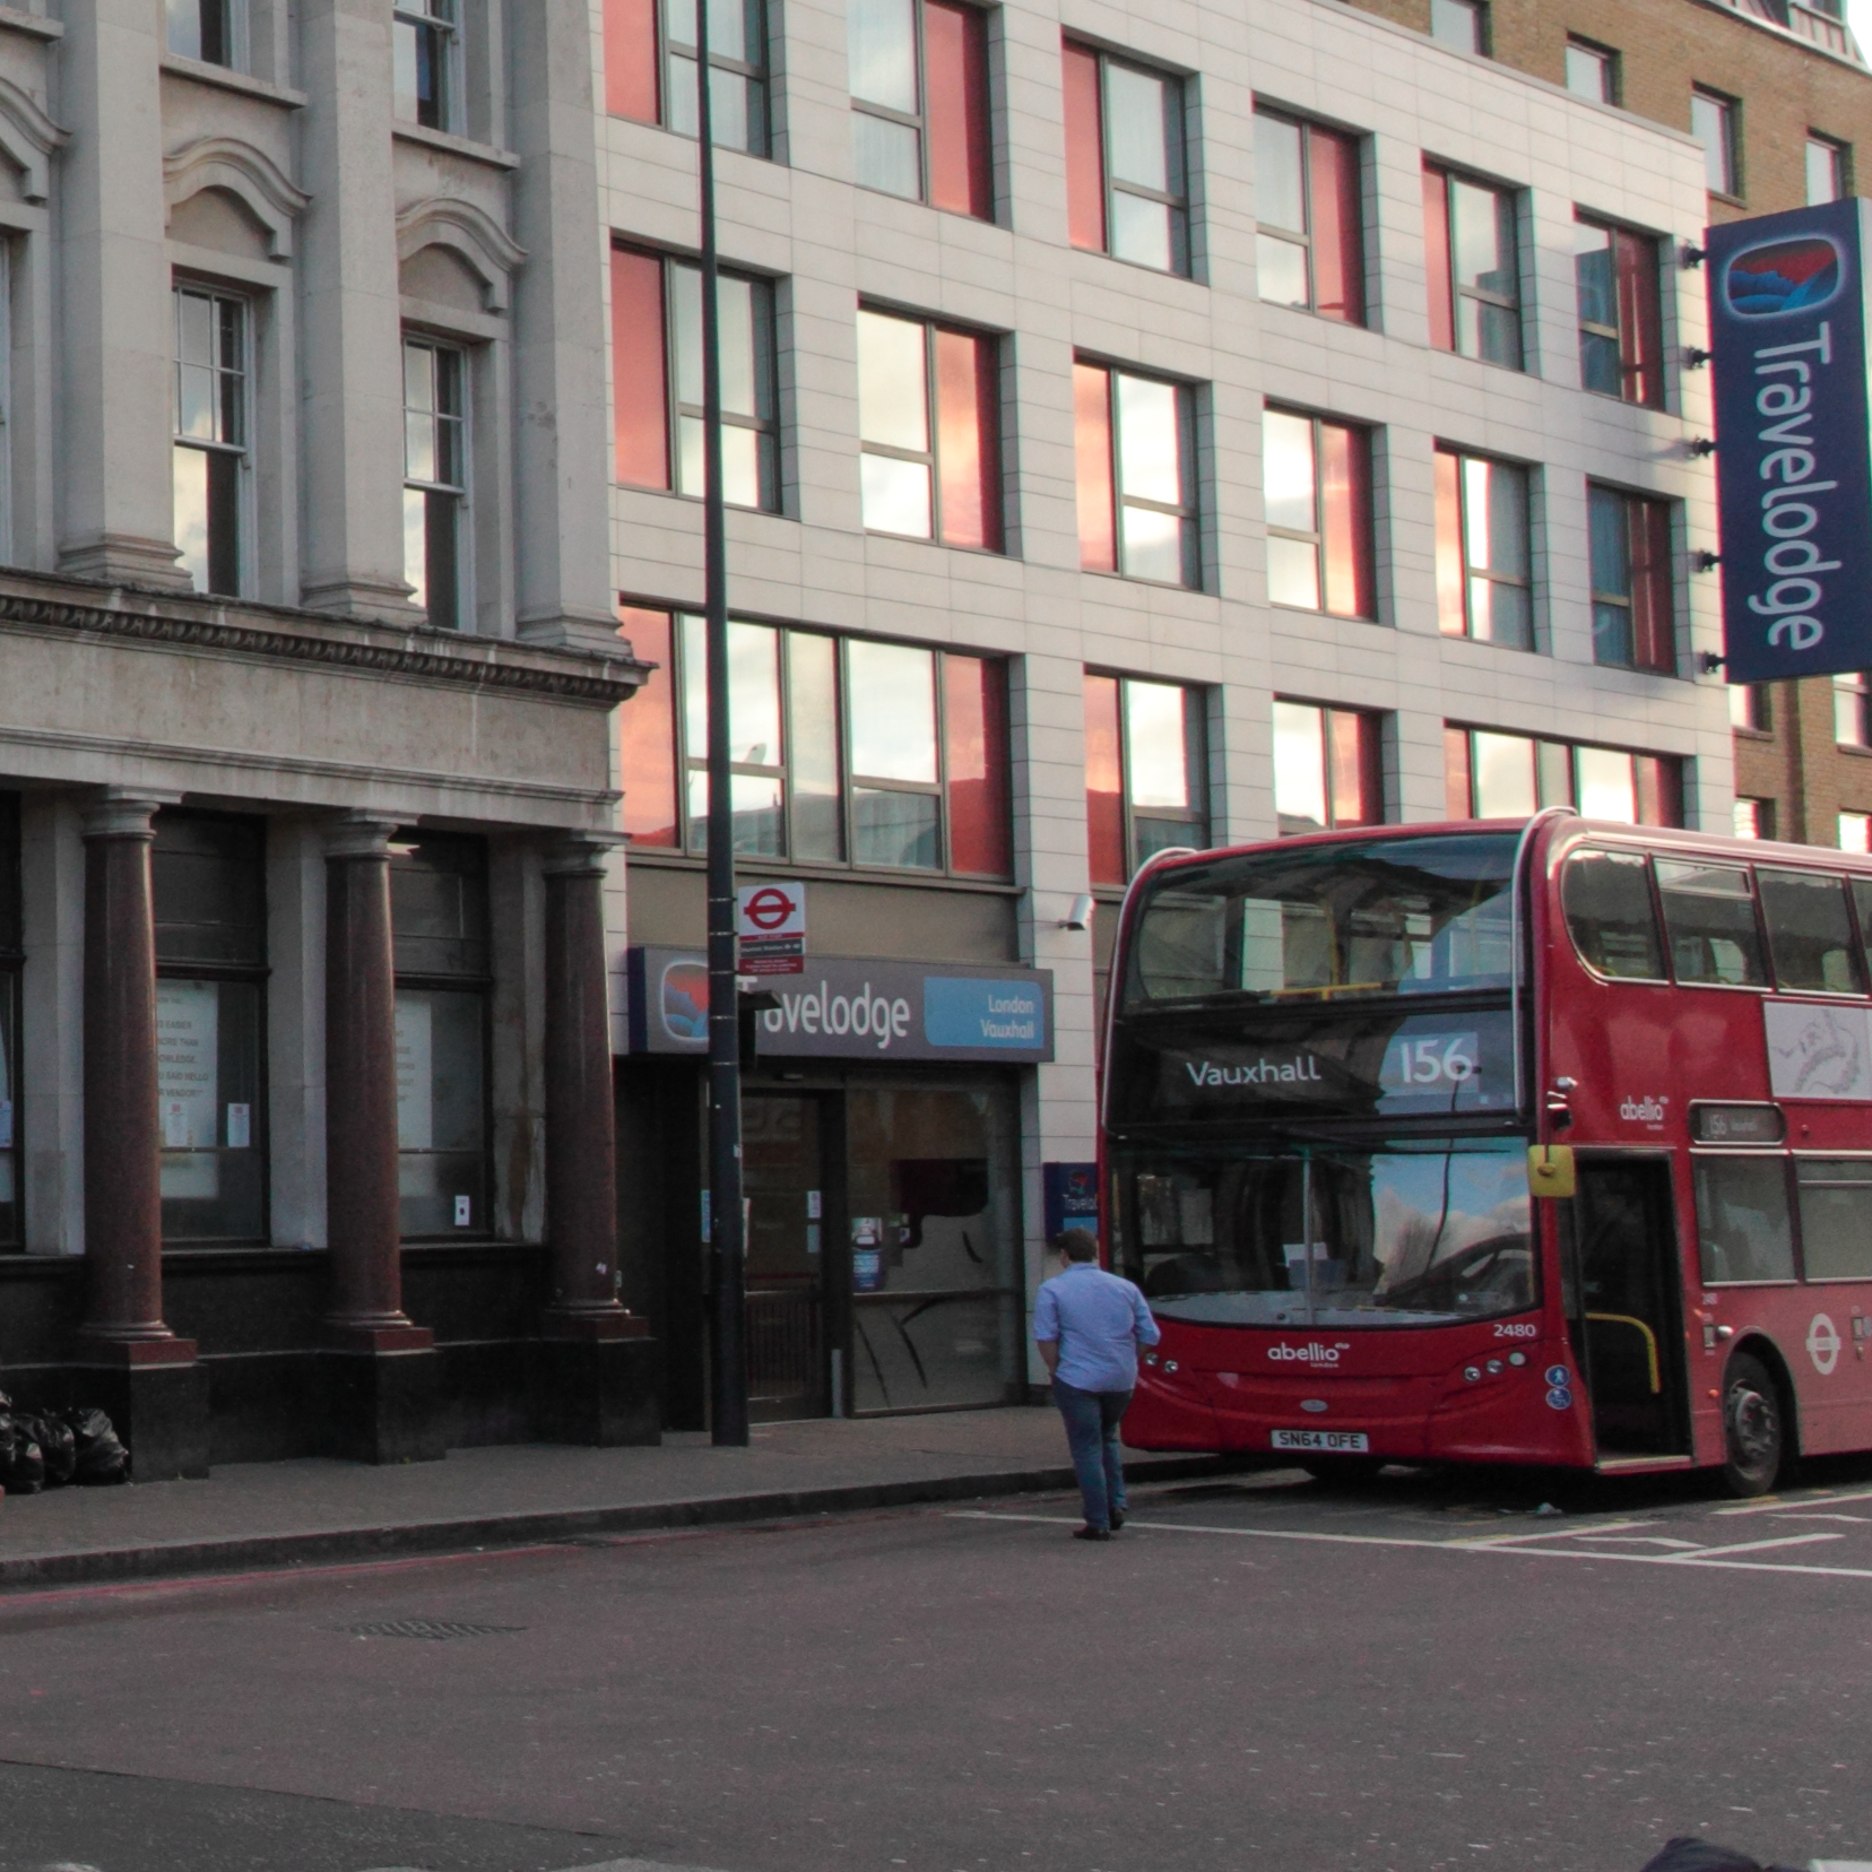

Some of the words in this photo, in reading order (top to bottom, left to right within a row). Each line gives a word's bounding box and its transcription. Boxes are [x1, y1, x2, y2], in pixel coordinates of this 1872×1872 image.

[1746, 321, 1843, 650] Travelodge
[988, 994, 1034, 1014] London
[980, 1019, 1035, 1039] Vauxhall
[1185, 1055, 1322, 1086] Vauxhall
[1400, 1038, 1473, 1083] 156
[1620, 1095, 1664, 1121] abellio
[1492, 1323, 1537, 1338] 2480
[1267, 1341, 1340, 1361] abellio
[1278, 1432, 1322, 1446] SN64
[1327, 1434, 1361, 1449] OFE
